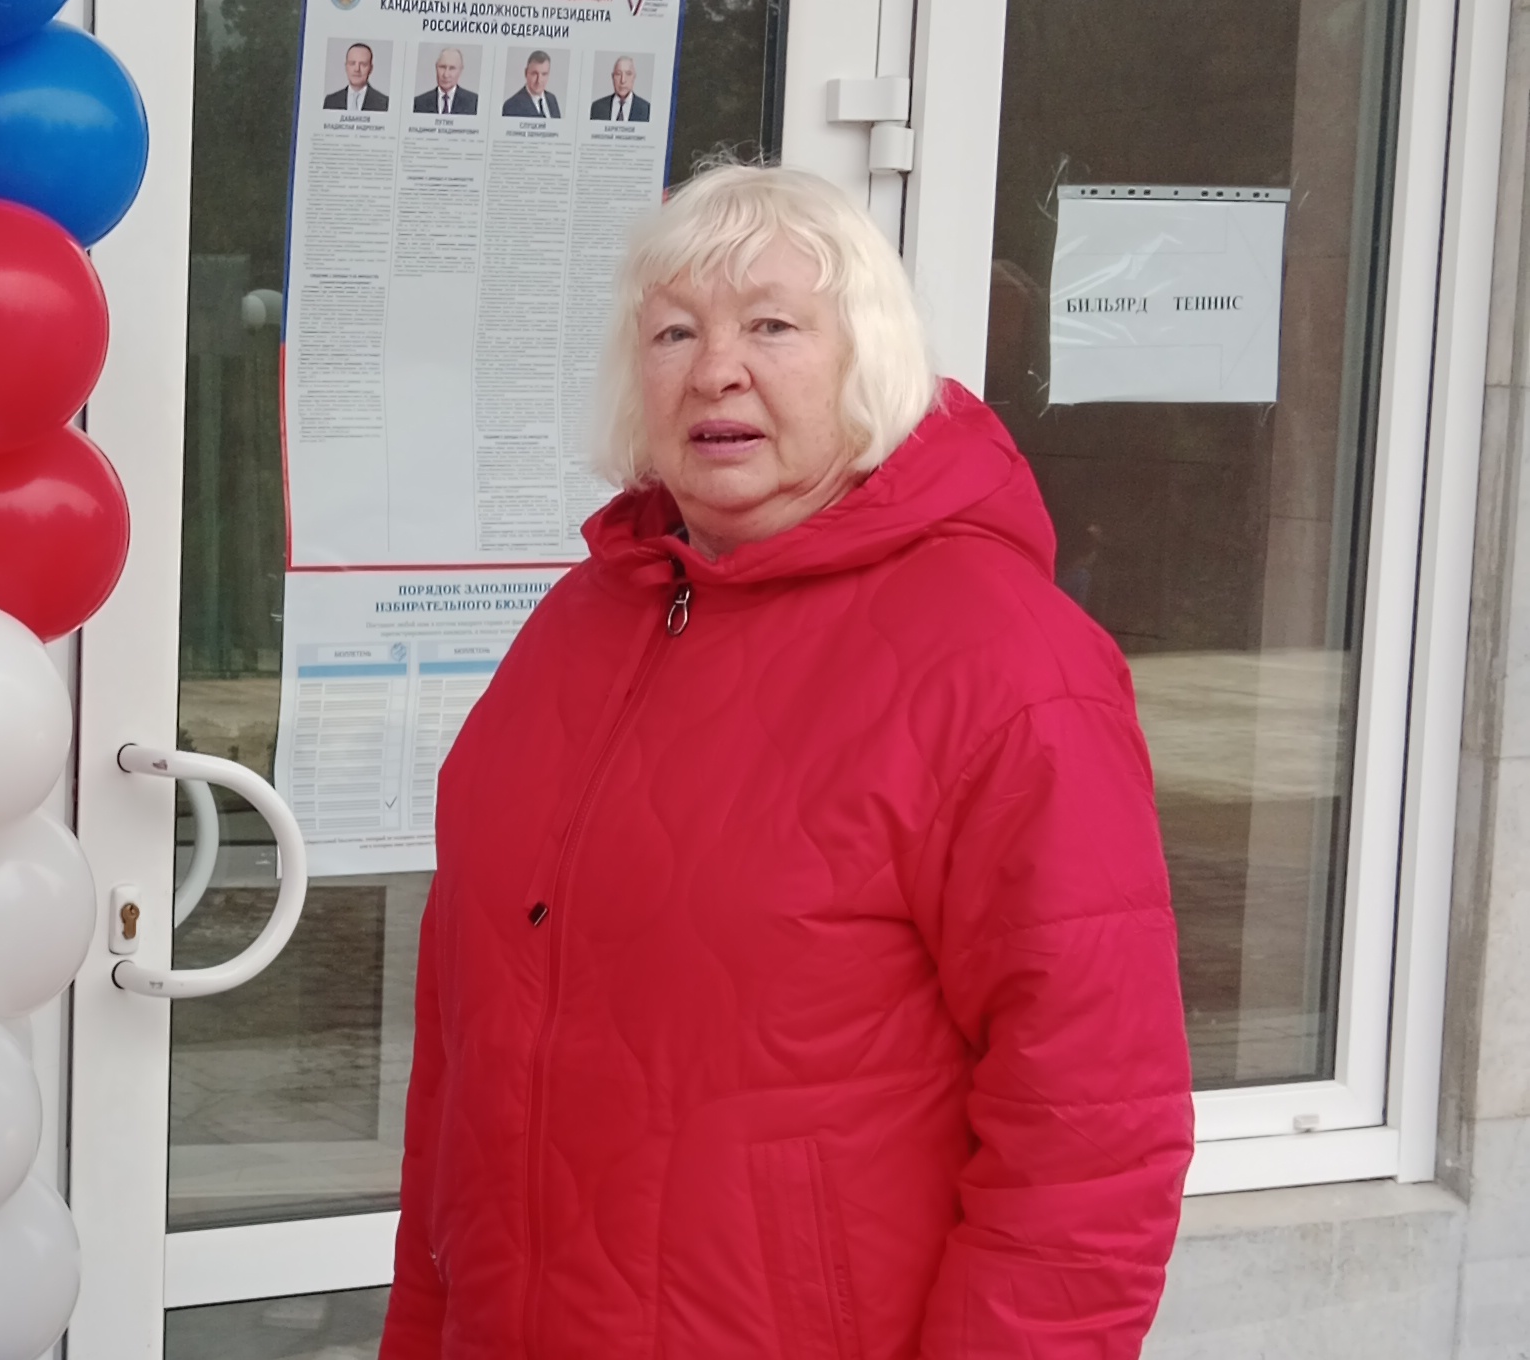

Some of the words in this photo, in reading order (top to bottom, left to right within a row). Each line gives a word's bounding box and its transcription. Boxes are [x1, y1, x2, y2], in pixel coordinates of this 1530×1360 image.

[453, 1, 468, 15] НА
[470, 2, 539, 19] ДОЛЖНОСТЬ
[542, 6, 612, 23] ПРЕЗИДЕНТА
[422, 17, 498, 35] РОССИЙСКОЙ
[500, 22, 570, 39] ФЕДЕРАЦИИ
[1066, 296, 1149, 314] БИЛЬЯРД
[1172, 295, 1244, 312] ТЕННИС
[398, 584, 461, 597] ПОРЯДОК
[375, 599, 492, 613] ИЗБИРАТЕЛЬНОГО
